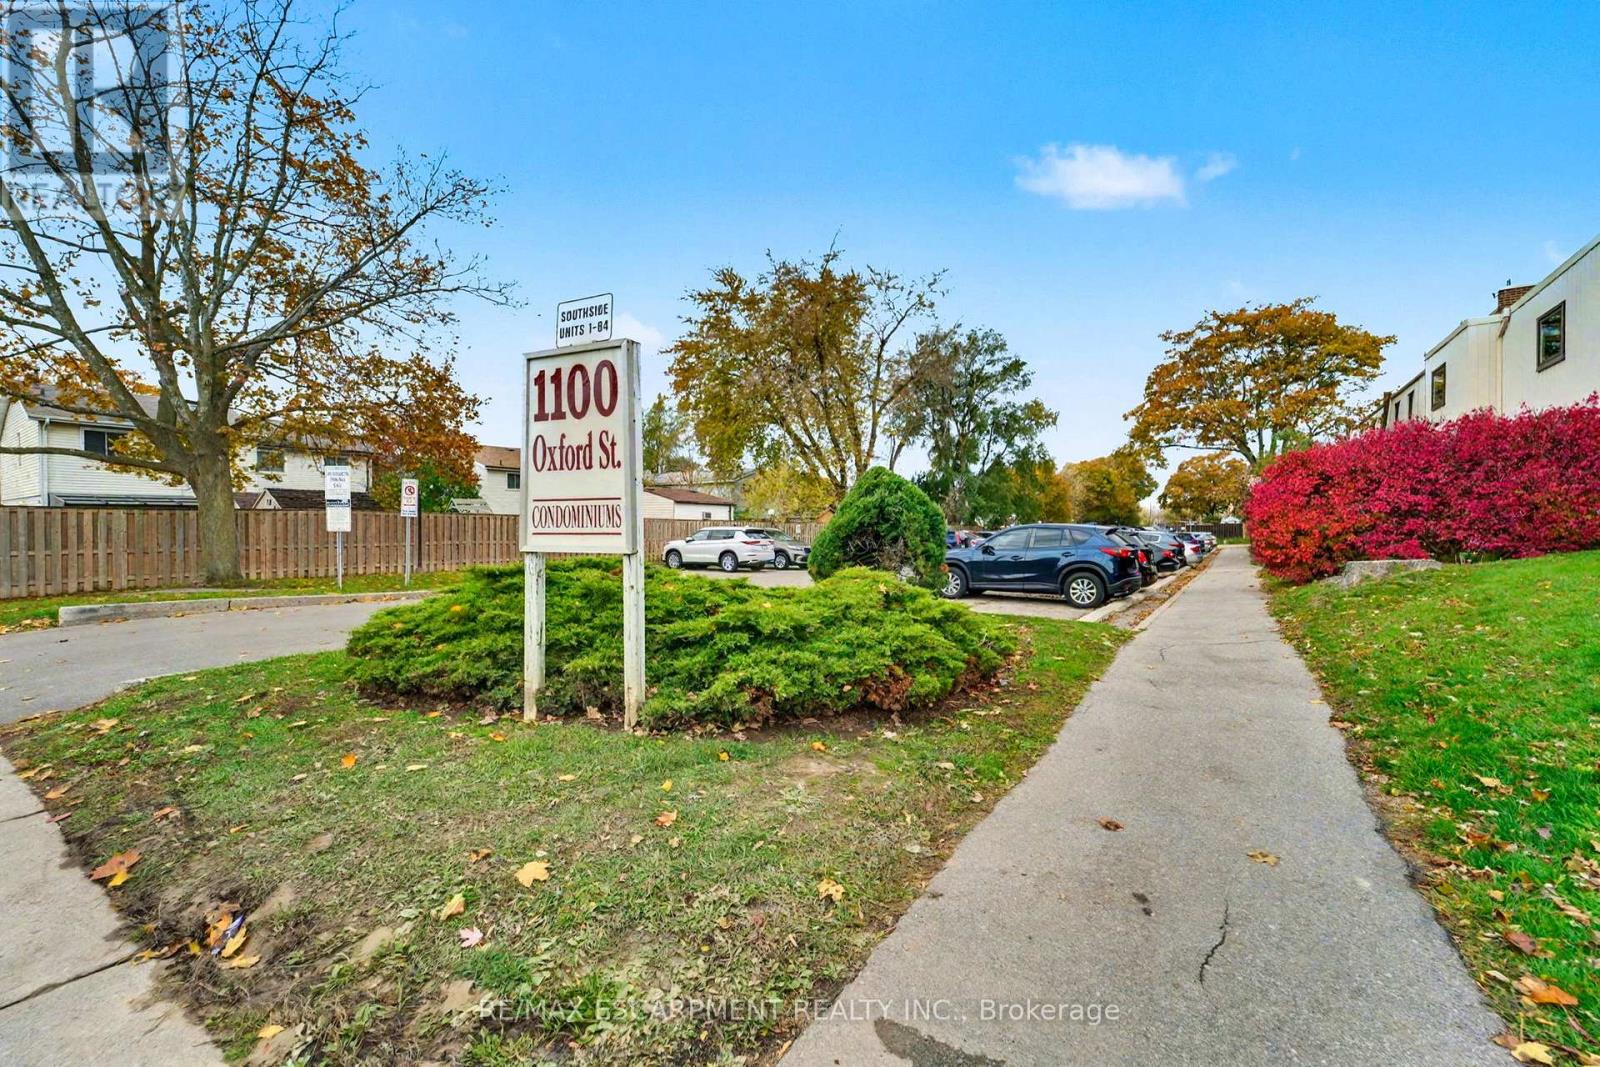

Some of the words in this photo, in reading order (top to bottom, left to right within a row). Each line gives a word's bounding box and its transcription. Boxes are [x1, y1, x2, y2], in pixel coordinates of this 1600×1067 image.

[561, 303, 608, 322] SOUTHSIDE
[560, 325, 585, 339] UNITS
[534, 359, 618, 422] 1100
[533, 430, 593, 472] Oxford
[599, 430, 621, 469] St.
[532, 504, 621, 528] CONDOMINIUMS
